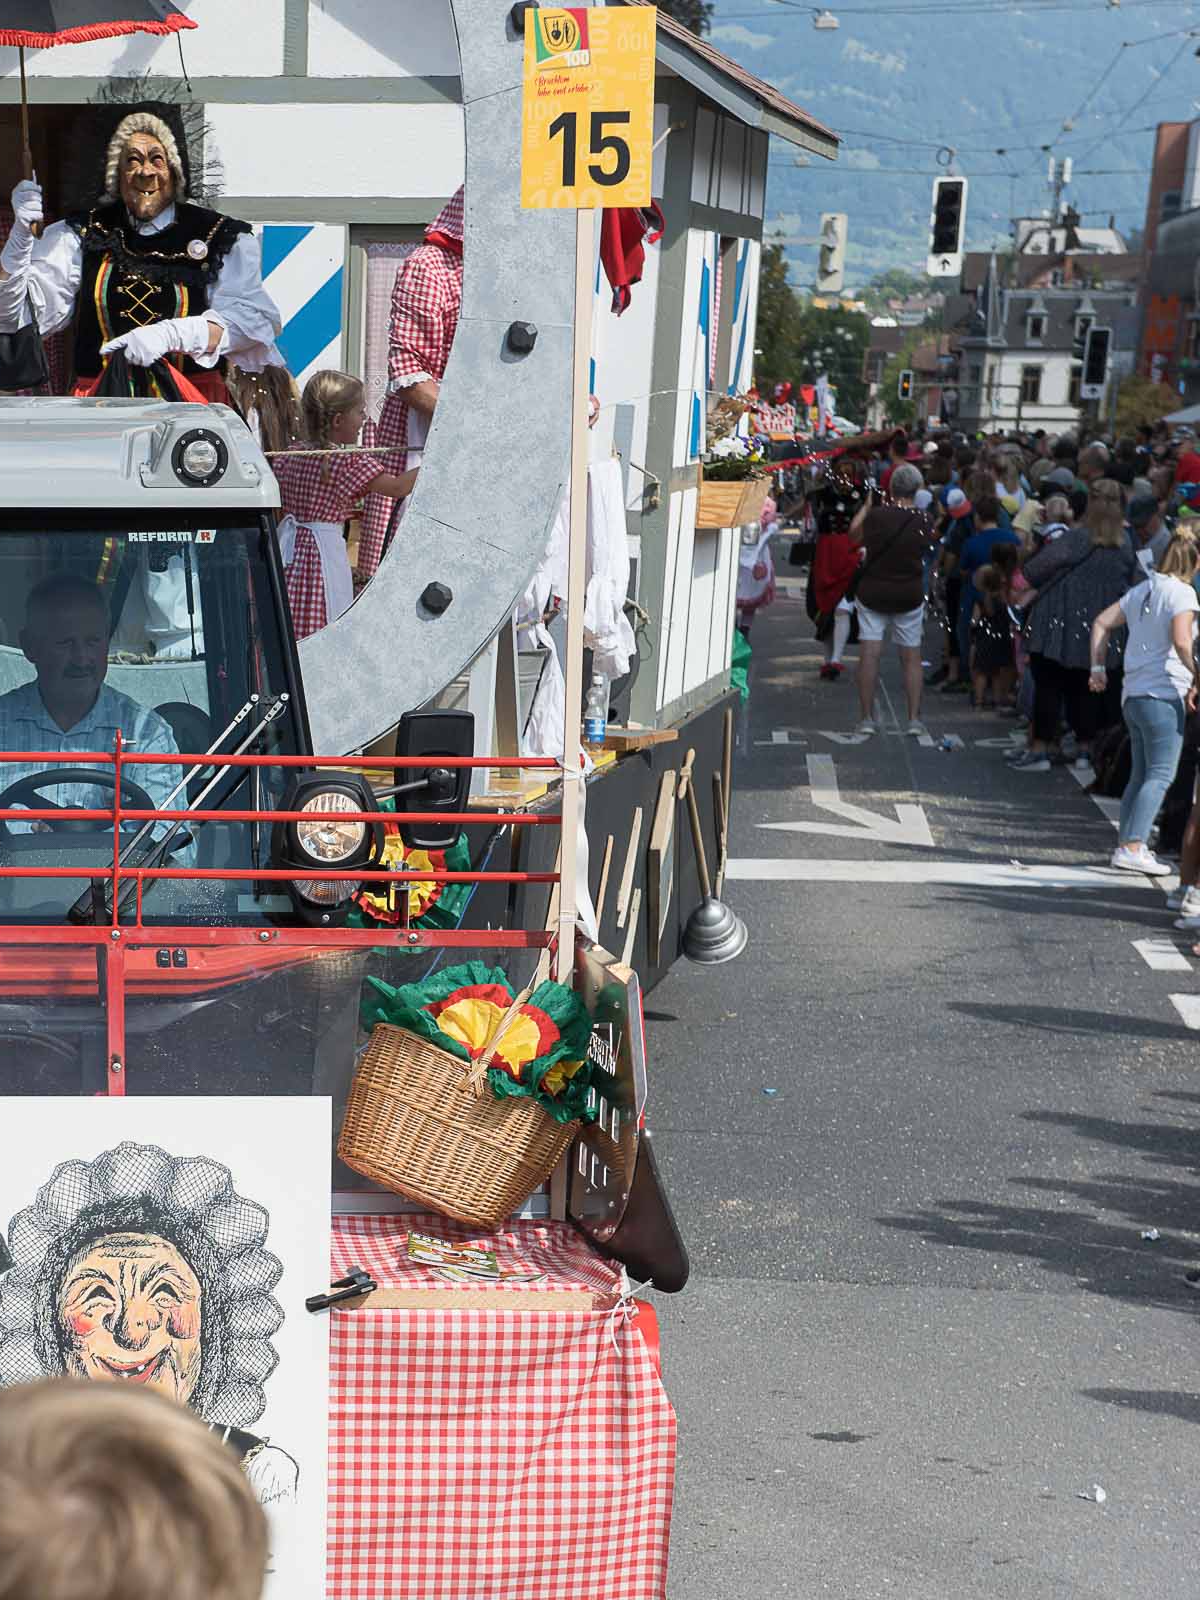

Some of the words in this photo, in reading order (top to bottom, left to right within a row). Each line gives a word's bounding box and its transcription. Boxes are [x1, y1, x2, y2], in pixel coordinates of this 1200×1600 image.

[565, 52, 589, 67] 100
[549, 111, 631, 187] 15
[128, 531, 192, 542] REFORM
